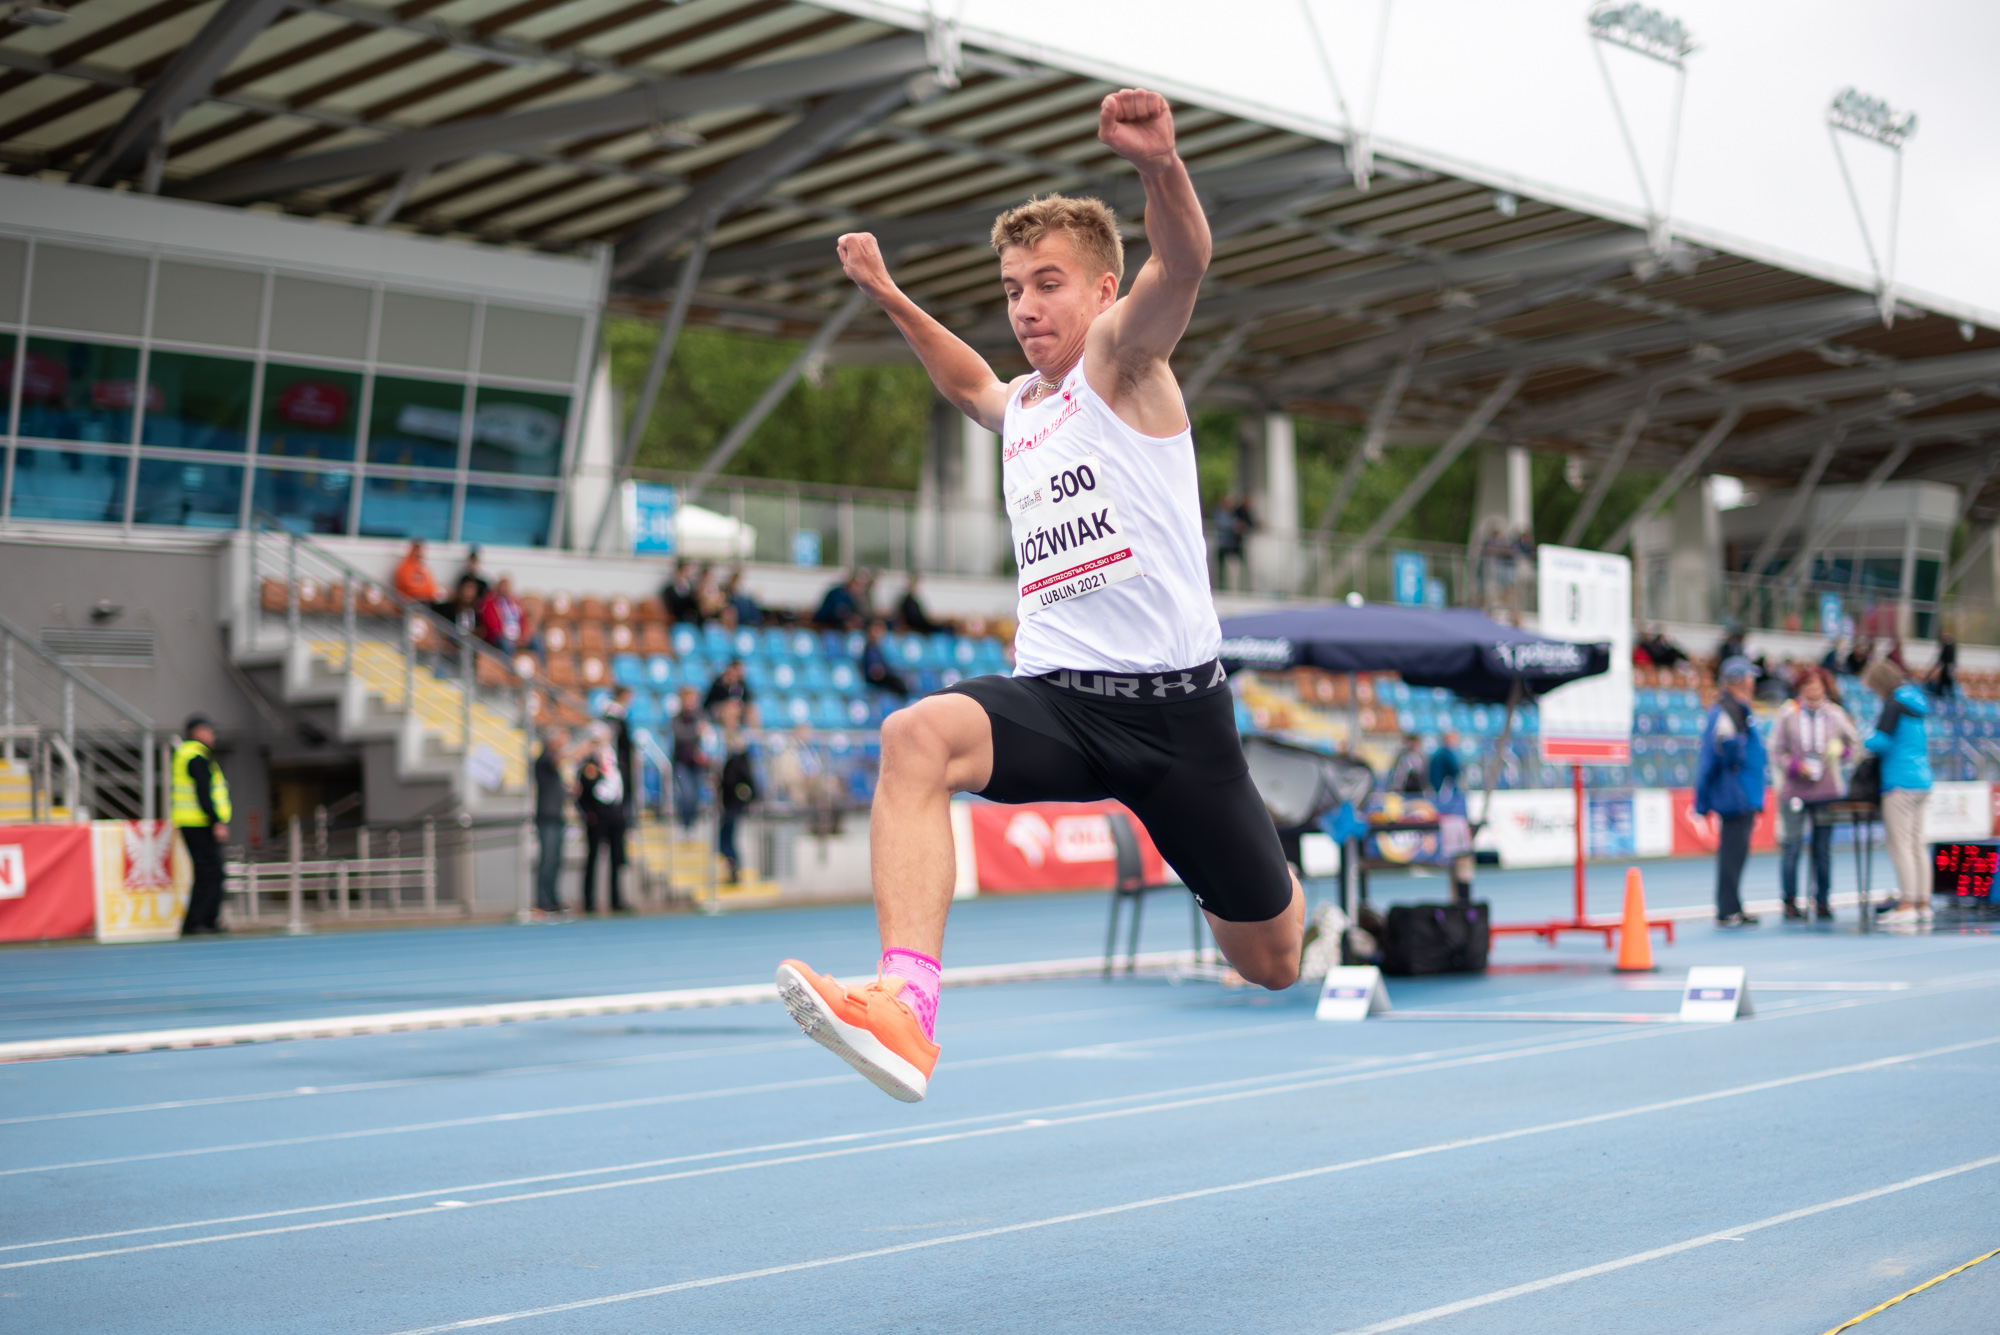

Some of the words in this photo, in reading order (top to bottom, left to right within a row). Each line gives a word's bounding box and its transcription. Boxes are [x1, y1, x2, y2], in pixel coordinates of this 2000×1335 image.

[1050, 464, 1096, 503] 500
[1020, 507, 1117, 570] JÓŹWIAK
[1042, 566, 1085, 586] MISTRZOSTWA
[1084, 557, 1110, 571] POLSKI
[1110, 551, 1127, 562] U20
[1039, 582, 1078, 606] LUBLIN
[1077, 572, 1107, 593] 2021
